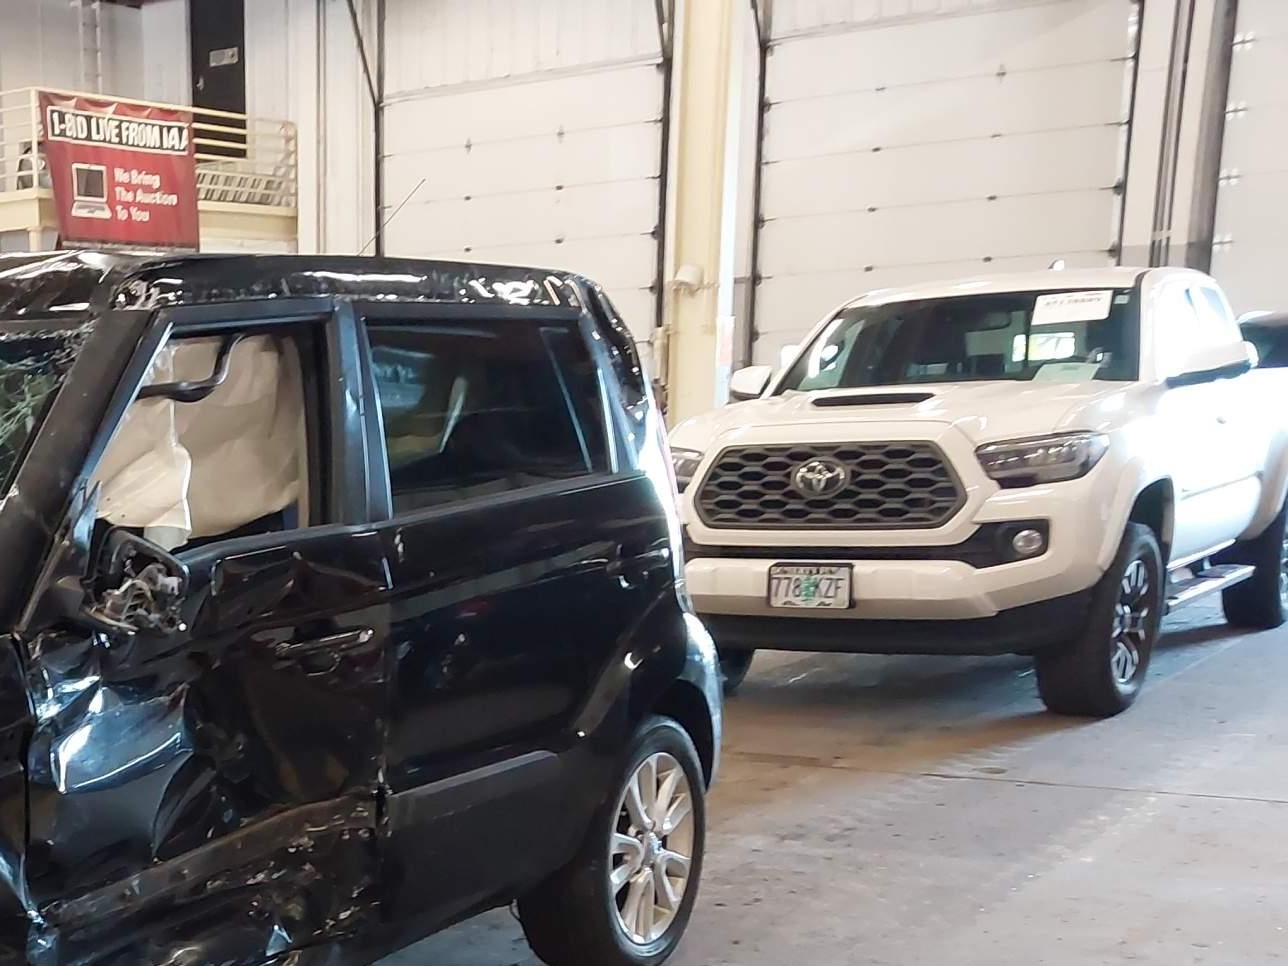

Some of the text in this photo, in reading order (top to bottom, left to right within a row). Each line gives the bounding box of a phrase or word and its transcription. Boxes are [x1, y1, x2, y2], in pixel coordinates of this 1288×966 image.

[91, 117, 120, 144] LIVE
[121, 122, 161, 149] FROM
[114, 168, 160, 190] We Bring
[114, 187, 178, 206] The Auction
[115, 206, 150, 222] To You
[771, 577, 802, 598] 778
